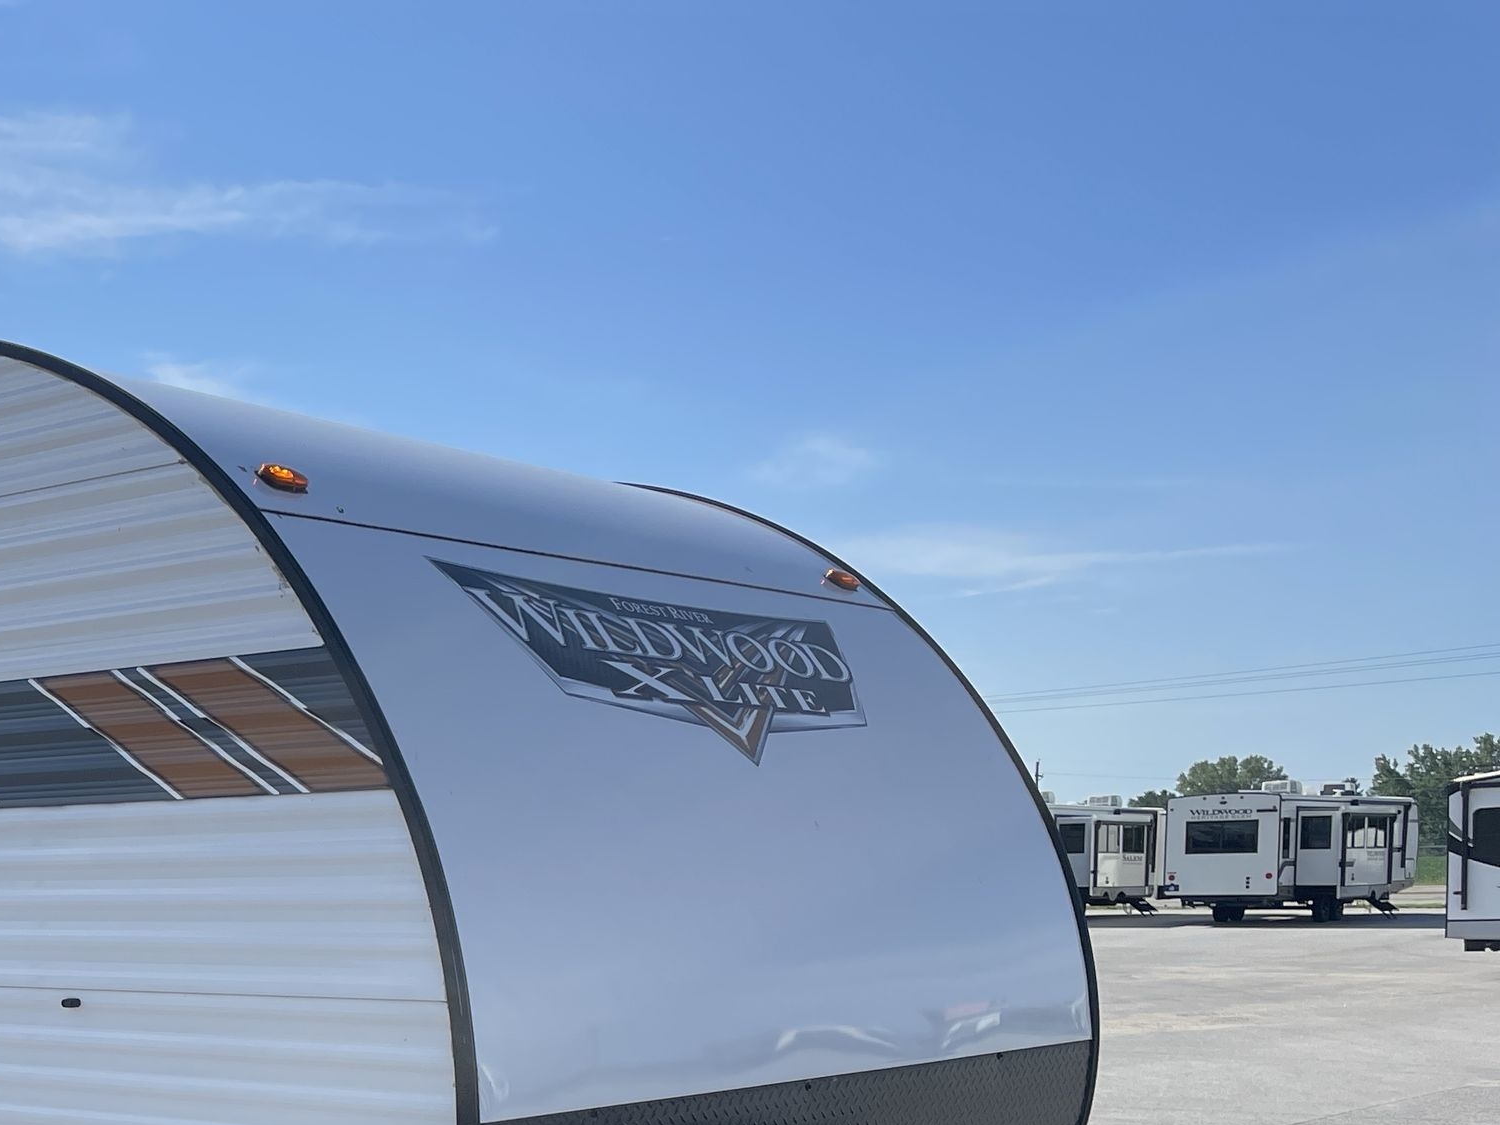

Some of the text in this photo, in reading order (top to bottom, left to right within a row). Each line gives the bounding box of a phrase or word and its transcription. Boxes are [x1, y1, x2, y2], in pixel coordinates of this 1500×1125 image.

[608, 597, 714, 624] FOREST RIVER
[462, 586, 852, 684] WILDWOOD
[1189, 808, 1253, 816] WILDWOOD
